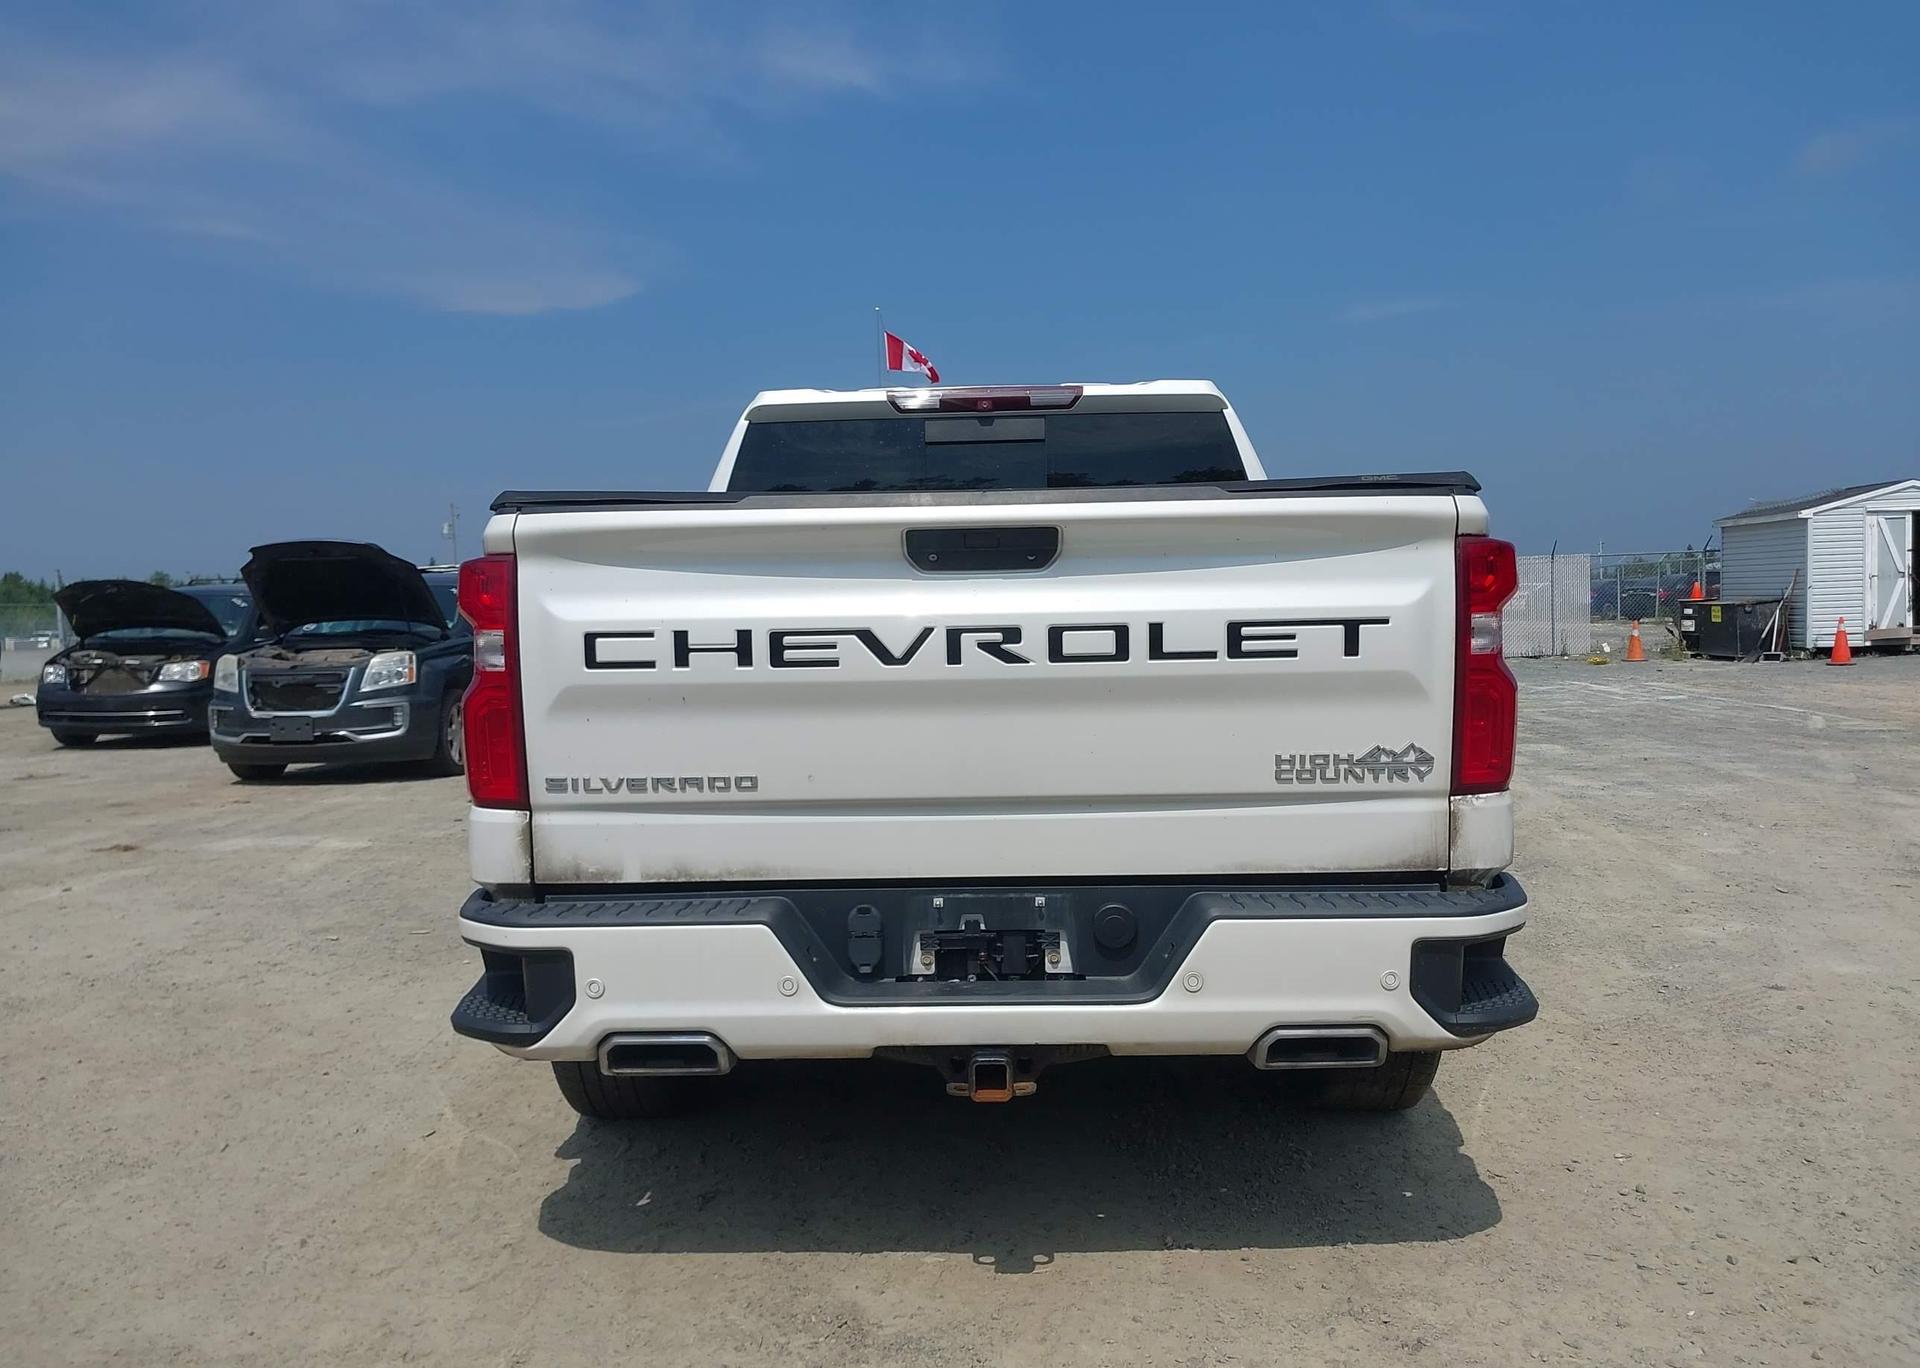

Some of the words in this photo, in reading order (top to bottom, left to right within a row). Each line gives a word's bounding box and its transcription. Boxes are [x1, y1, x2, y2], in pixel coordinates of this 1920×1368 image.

[584, 617, 1390, 669] CHEVROLET
[1275, 753, 1355, 769] HIGH
[1275, 767, 1434, 784] COUNTRY
[545, 776, 759, 794] SILVERADO
